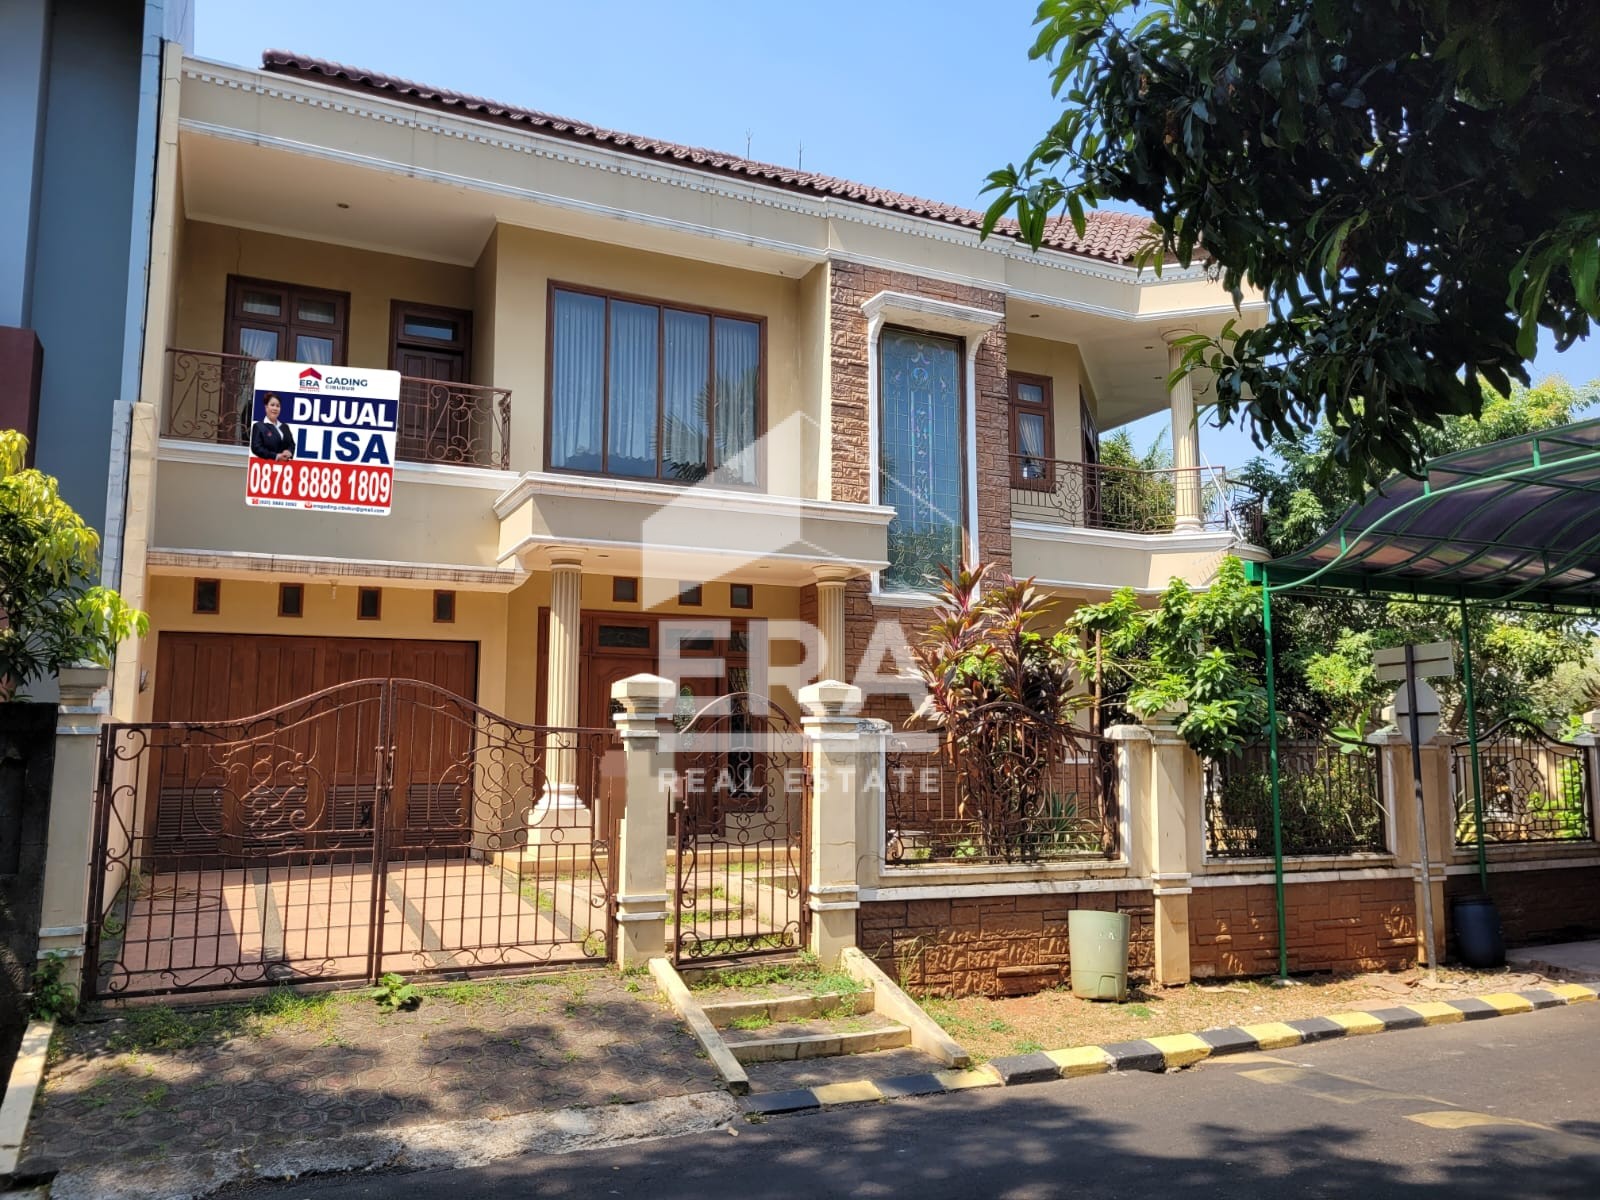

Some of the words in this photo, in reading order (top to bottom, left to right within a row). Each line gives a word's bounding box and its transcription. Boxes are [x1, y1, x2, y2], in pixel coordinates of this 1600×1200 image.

[299, 379, 320, 388] ERA
[325, 376, 368, 387] GADING
[292, 397, 394, 428] DIJUAL
[296, 428, 390, 465] LISA
[250, 462, 294, 496] 0878
[298, 466, 342, 500] 8888
[348, 469, 391, 503] 1809
